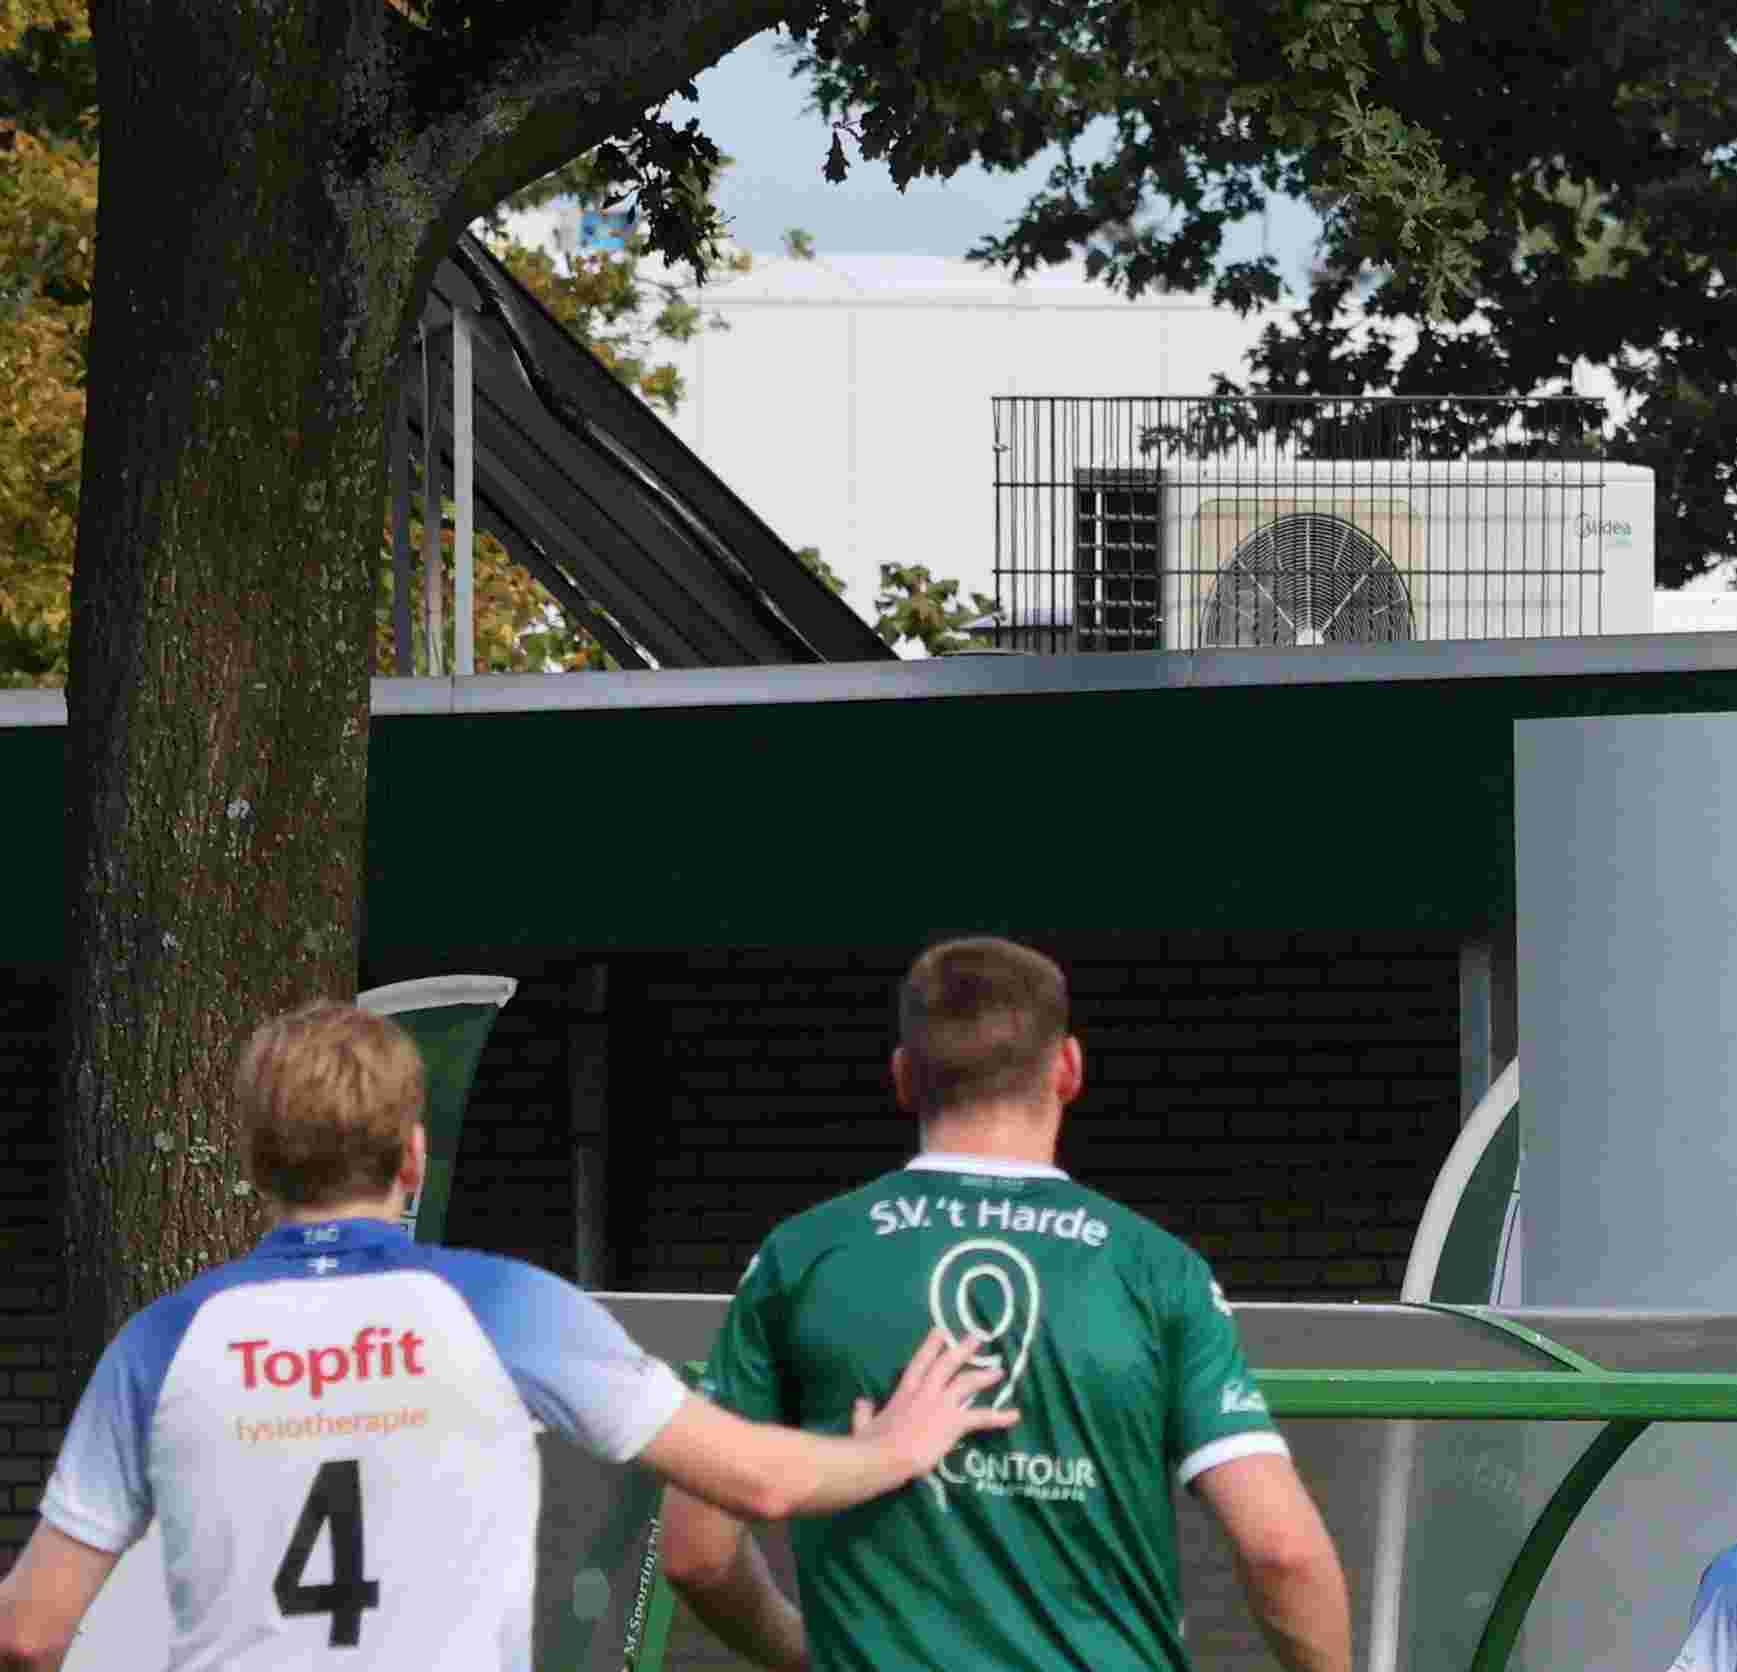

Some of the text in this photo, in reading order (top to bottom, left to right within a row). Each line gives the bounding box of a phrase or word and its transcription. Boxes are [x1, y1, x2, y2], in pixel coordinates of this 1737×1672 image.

[978, 1198, 1109, 1247] Harde
[227, 1326, 426, 1400] Topfit
[929, 1237, 1041, 1411] 9
[272, 1458, 380, 1649] 4
